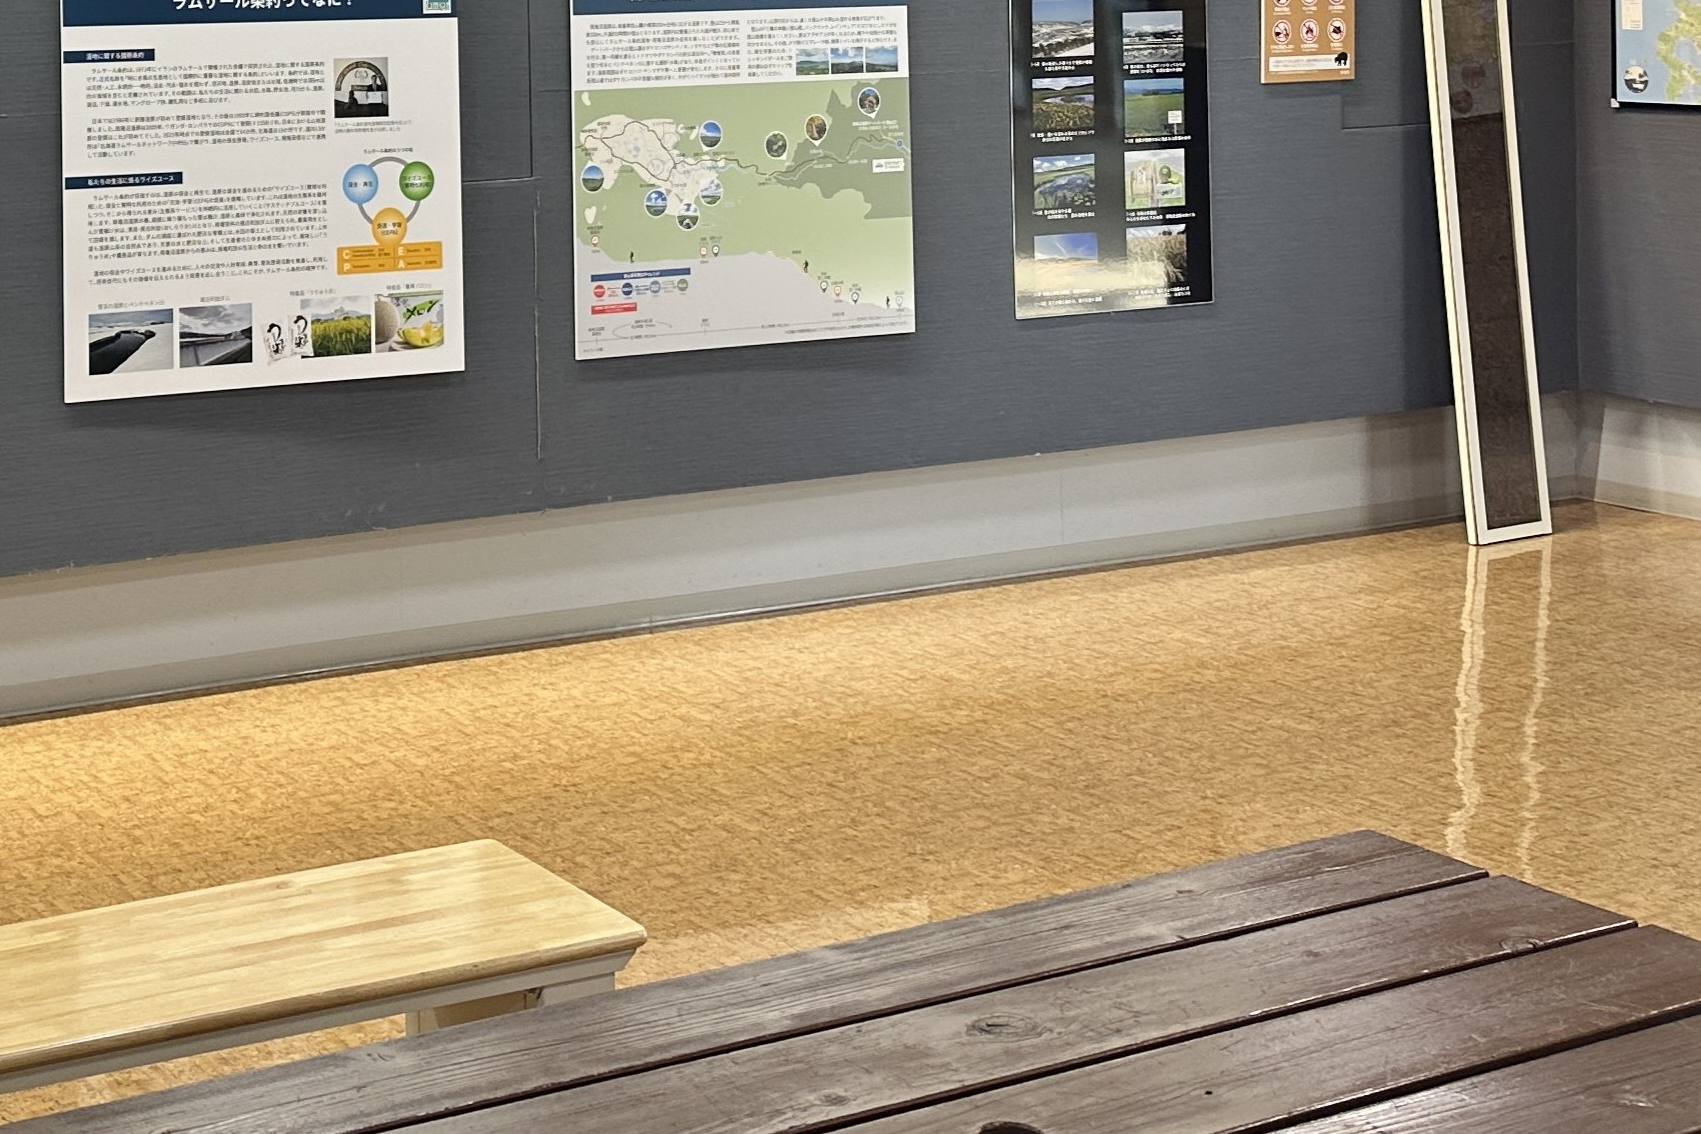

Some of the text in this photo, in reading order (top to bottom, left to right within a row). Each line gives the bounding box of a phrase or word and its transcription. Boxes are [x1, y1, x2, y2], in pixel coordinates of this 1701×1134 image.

[342, 249, 350, 260] C
[397, 246, 404, 255] E
[343, 262, 350, 272] P
[397, 259, 405, 269] A
